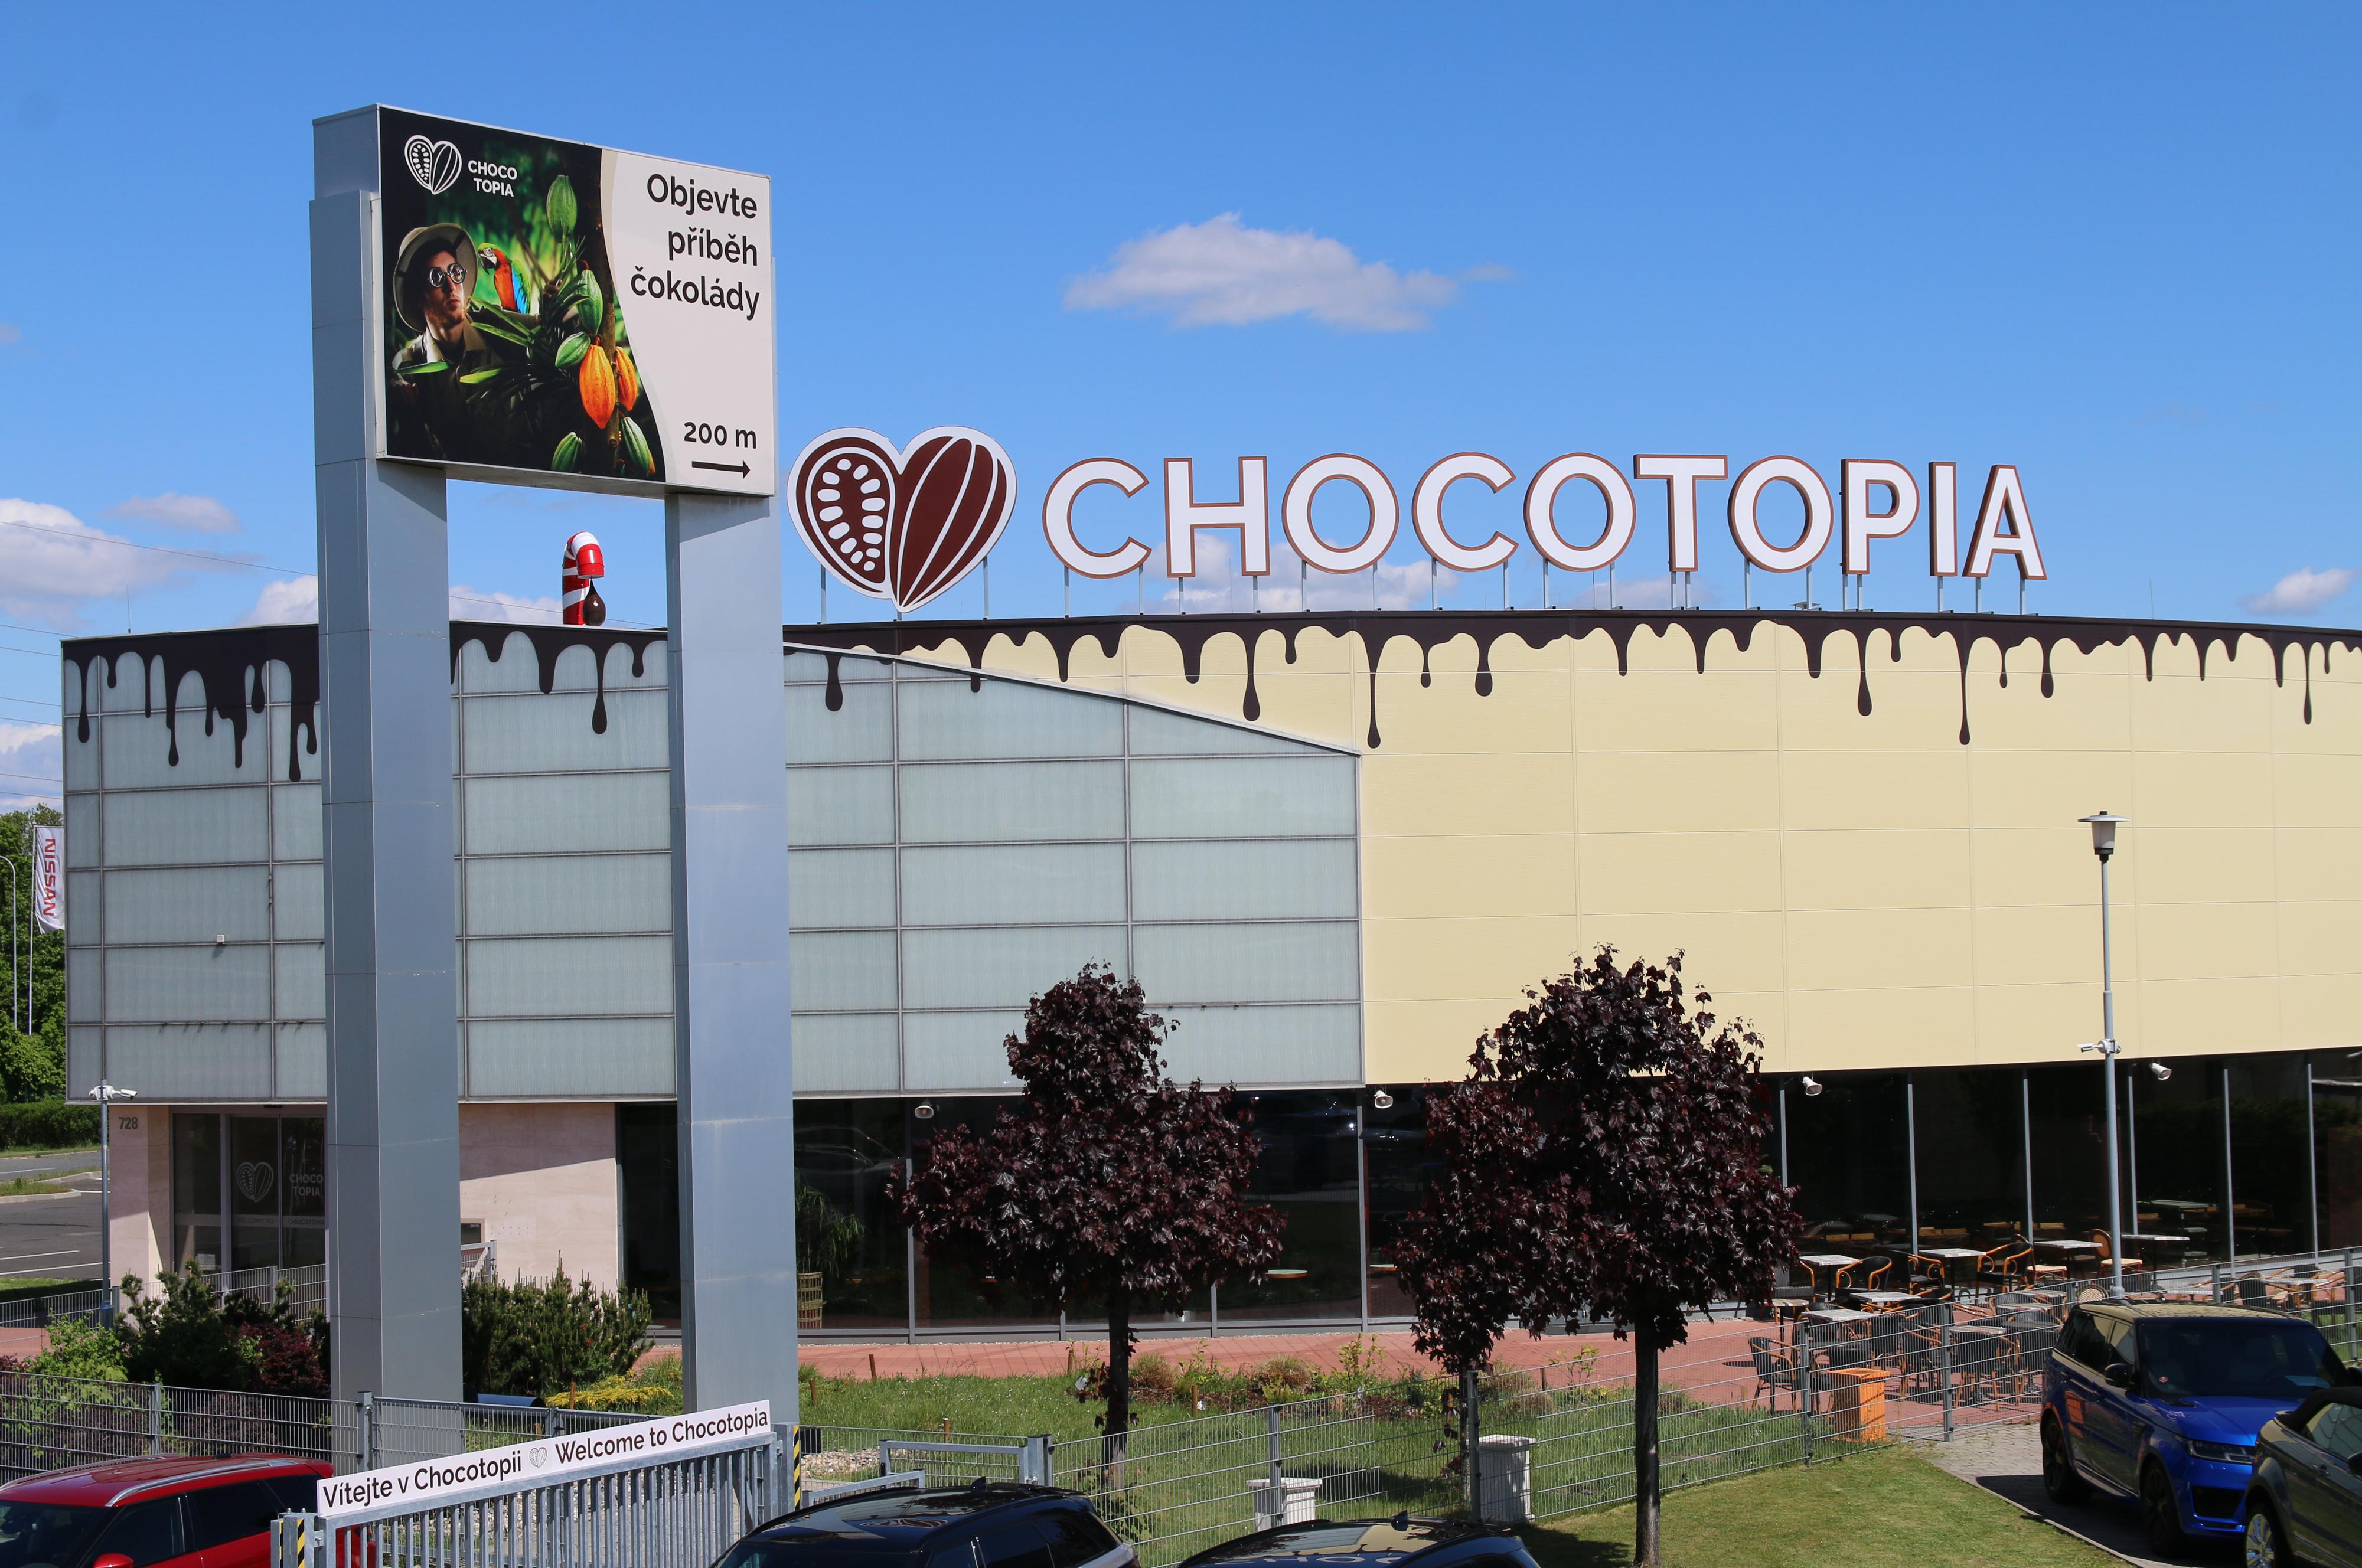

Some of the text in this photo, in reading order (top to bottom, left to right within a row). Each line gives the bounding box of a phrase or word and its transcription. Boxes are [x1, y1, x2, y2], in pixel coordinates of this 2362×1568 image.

[468, 159, 518, 180] CHOCO
[473, 177, 514, 198] TOPIA
[647, 173, 758, 219] Objevte
[668, 226, 758, 266] příběh
[631, 266, 760, 321] čokolády
[684, 422, 756, 449] 200 m
[1042, 452, 2048, 580] CHOCOTOPIA
[43, 838, 56, 916] NISSAN
[119, 1116, 138, 1130] 728
[289, 1173, 324, 1184] CHOCO
[292, 1186, 321, 1197] TOPIA
[323, 1407, 768, 1507] Vítejte v Chocotopii Welcome to Chocotopia
